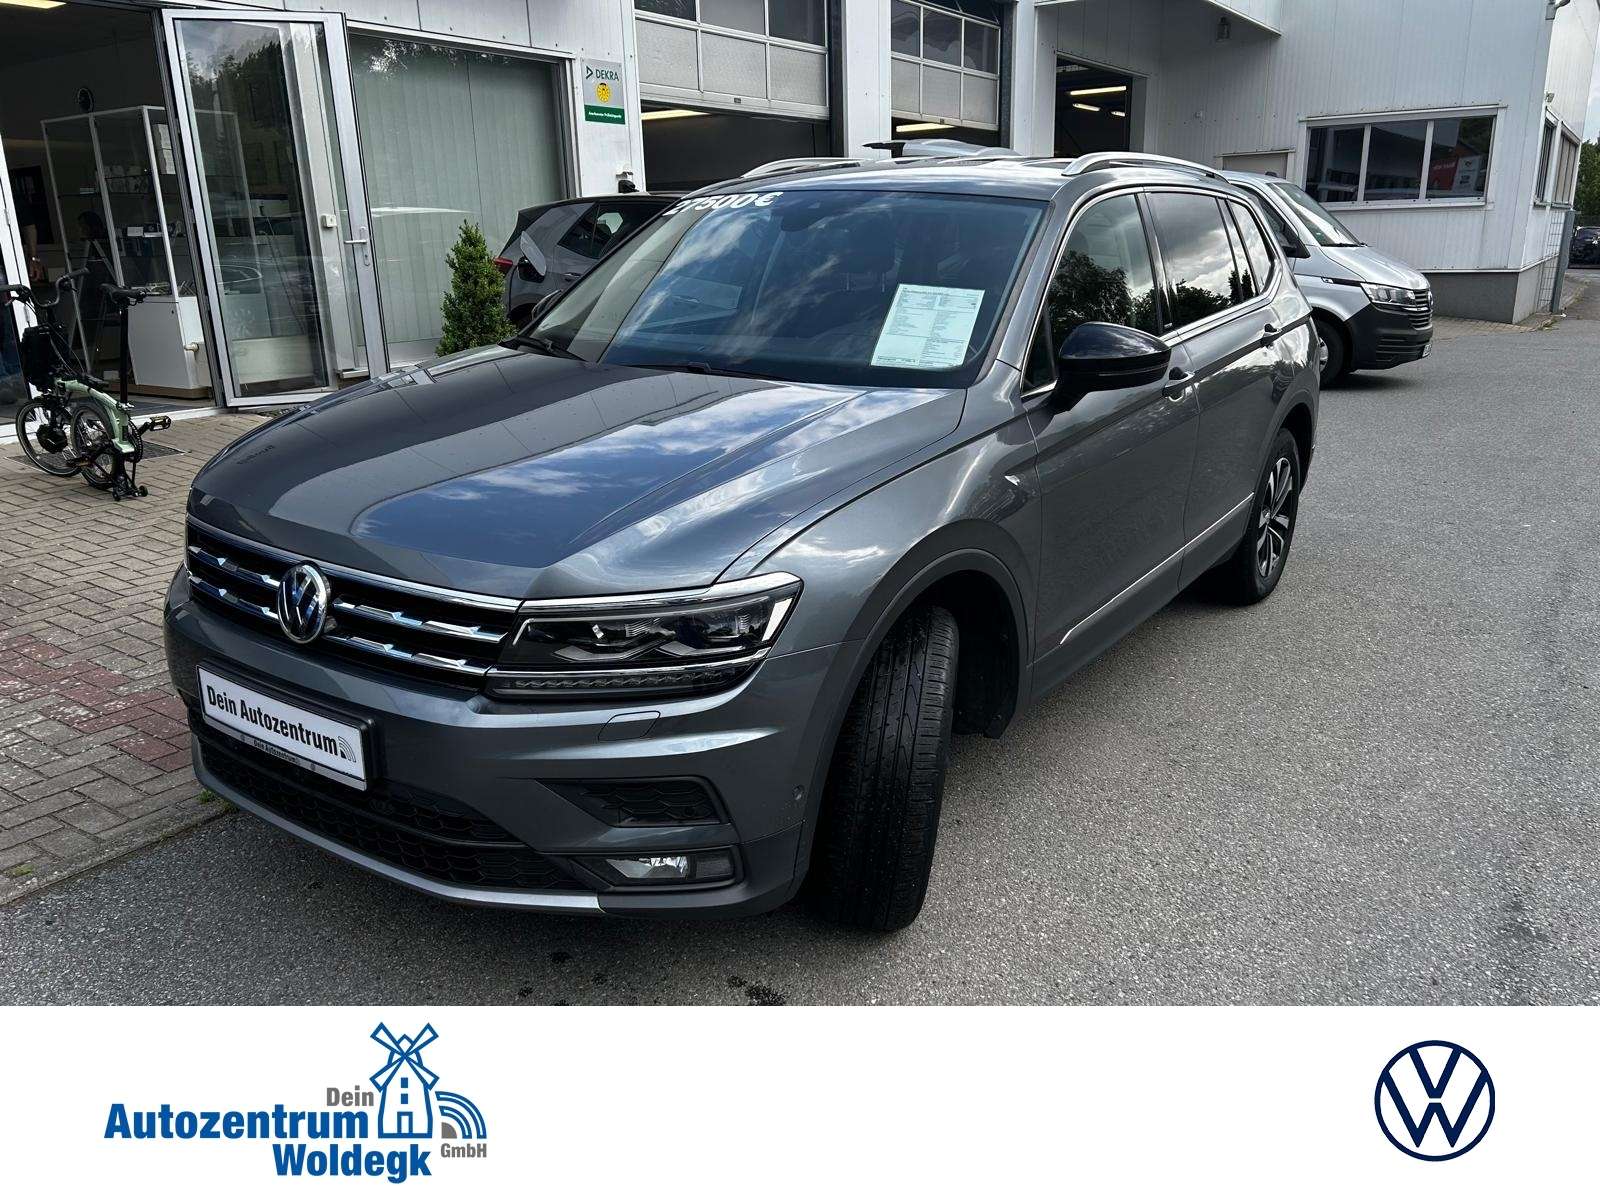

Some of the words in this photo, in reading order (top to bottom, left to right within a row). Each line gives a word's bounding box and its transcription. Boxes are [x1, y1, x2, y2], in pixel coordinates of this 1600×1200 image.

[595, 69, 620, 81] DEKRA
[207, 685, 238, 716] Dein
[241, 700, 338, 756] Autozentrum
